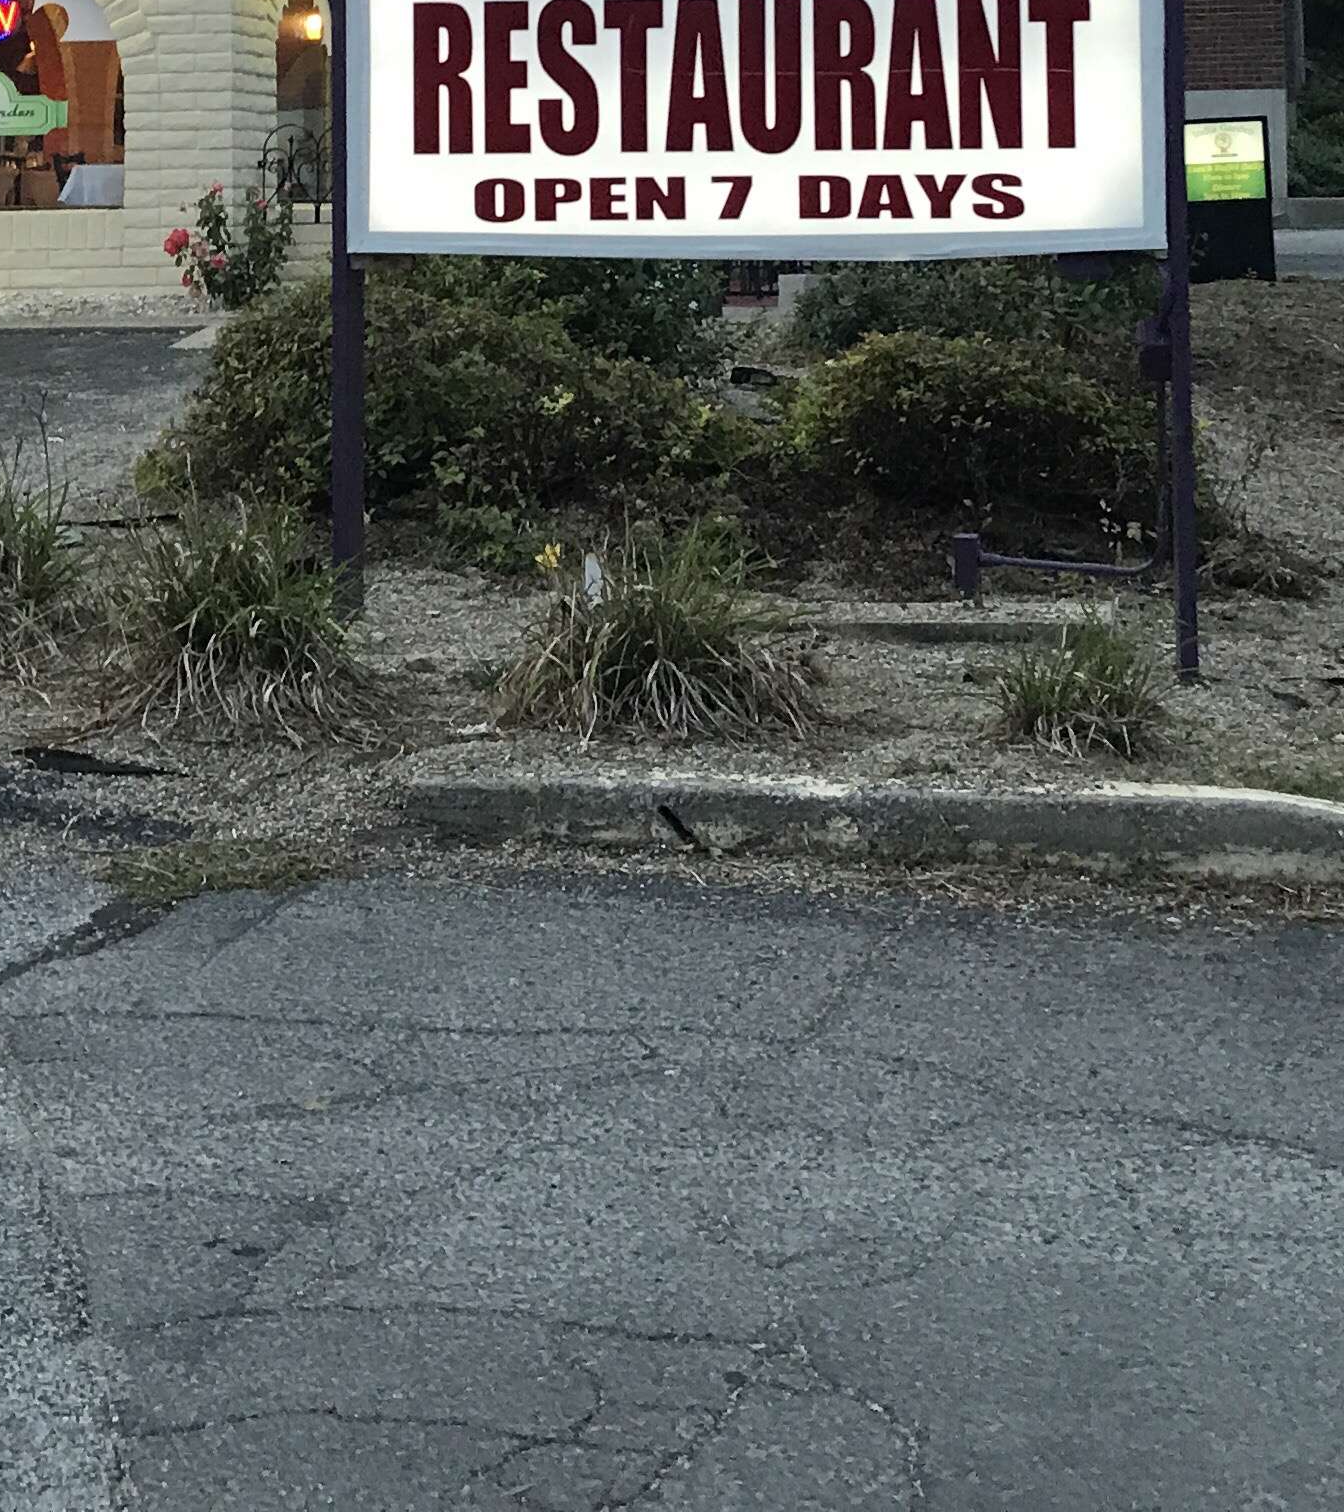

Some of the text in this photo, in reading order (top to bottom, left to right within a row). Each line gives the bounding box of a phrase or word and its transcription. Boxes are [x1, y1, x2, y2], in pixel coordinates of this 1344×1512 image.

[474, 173, 1025, 223] OPEN 7 DAYS
